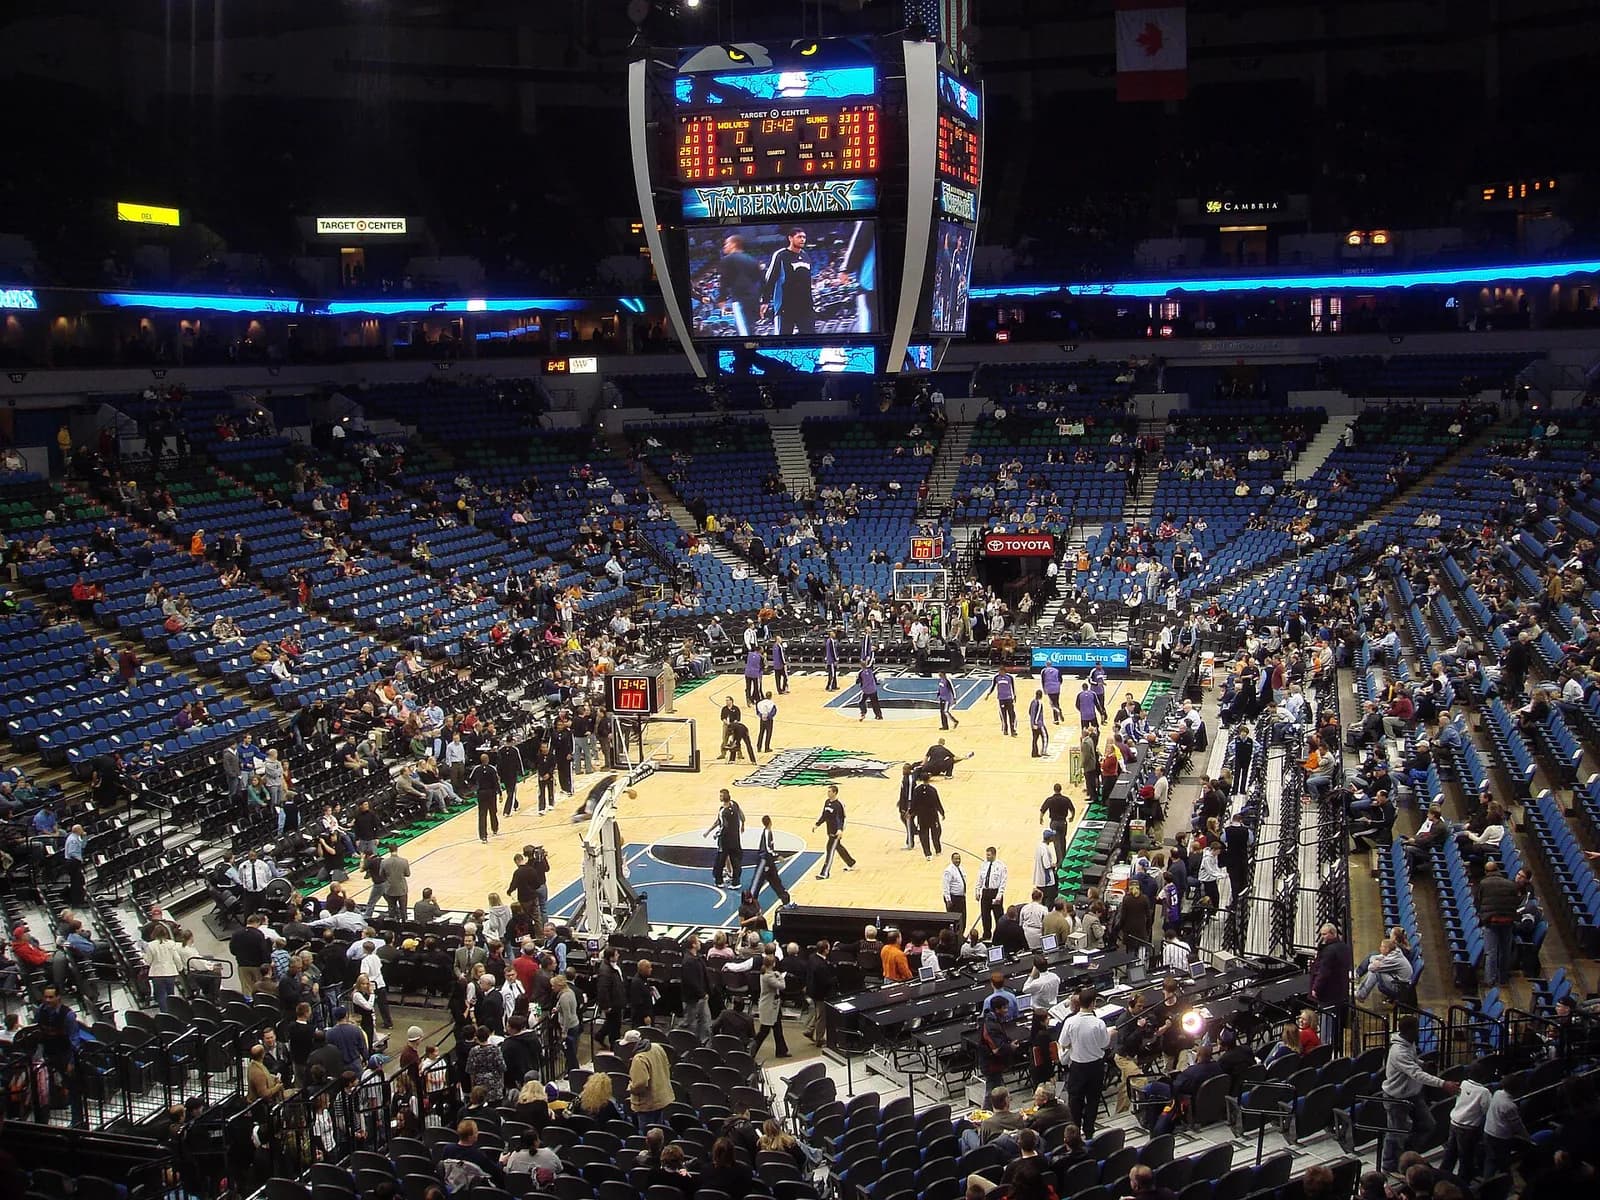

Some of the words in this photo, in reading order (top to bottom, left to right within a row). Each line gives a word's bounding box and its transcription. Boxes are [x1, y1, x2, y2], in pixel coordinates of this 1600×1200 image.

[839, 114, 850, 123] 33
[869, 113, 874, 121] 0
[693, 124, 699, 132] 0
[707, 123, 713, 131] 0
[718, 121, 750, 129] WOLVES
[762, 119, 794, 133] 13:42
[820, 126, 828, 138] 0
[839, 126, 851, 135] 31
[693, 135, 699, 143] 0
[708, 134, 713, 142] 0
[736, 131, 744, 144] 0
[854, 137, 859, 145] 0
[869, 136, 874, 144] 0
[680, 147, 691, 155] 25
[842, 148, 852, 157] 19
[855, 148, 860, 156] 0
[870, 148, 874, 156] 0
[680, 158, 692, 167] 55
[806, 162, 812, 171] 0
[842, 161, 852, 169] 13
[855, 160, 860, 168] 0
[870, 159, 875, 168] 0
[686, 170, 692, 178] 3
[694, 169, 700, 177] 0
[708, 168, 714, 176] 0
[747, 166, 752, 174] 0
[738, 184, 819, 194] MINNESOTA
[696, 181, 856, 217] TIMBERWOLVES
[1005, 541, 1051, 550] TOYOTA
[916, 548, 929, 557] 00
[1051, 652, 1082, 663] Corona
[1086, 652, 1108, 662] Extra
[619, 680, 646, 690] 13:42
[621, 693, 641, 708] 00
